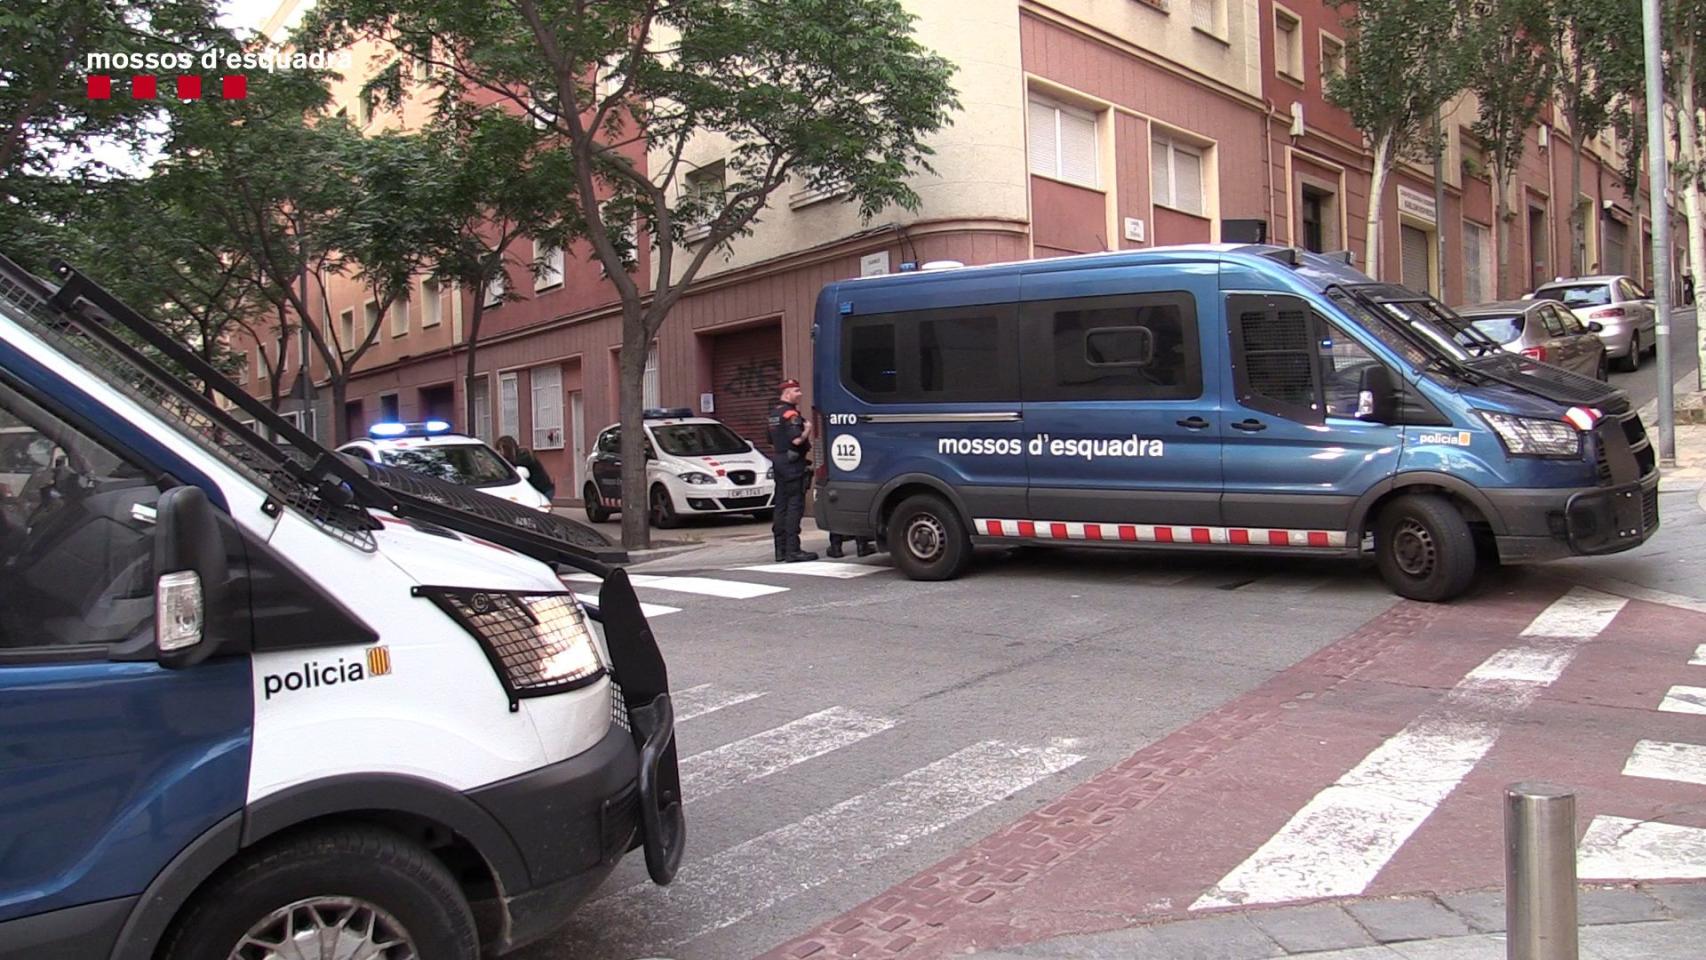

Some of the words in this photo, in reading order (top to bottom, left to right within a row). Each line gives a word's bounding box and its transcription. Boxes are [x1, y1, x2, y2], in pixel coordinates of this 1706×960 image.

[829, 412, 858, 425] arro
[1420, 432, 1458, 445] policia
[836, 443, 856, 457] 112
[937, 437, 1022, 455] mossos
[263, 657, 365, 700] policia
